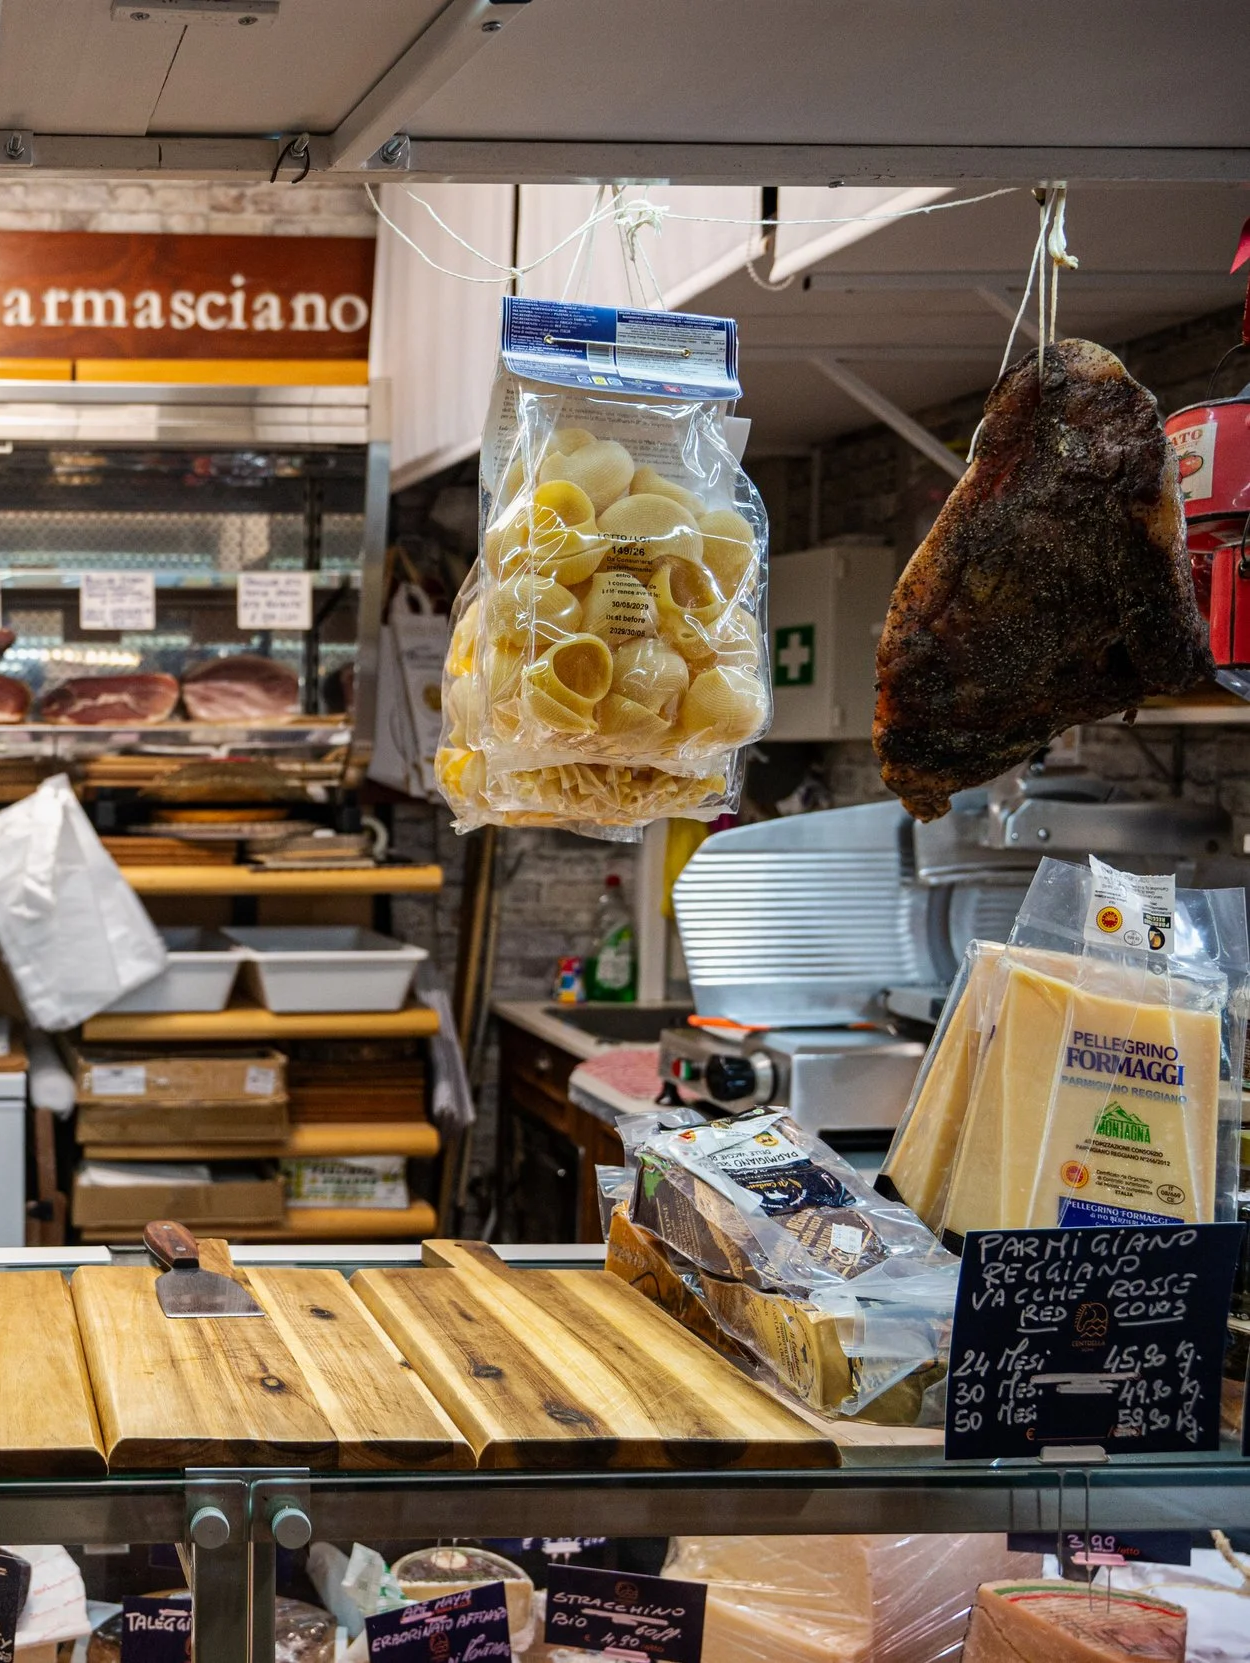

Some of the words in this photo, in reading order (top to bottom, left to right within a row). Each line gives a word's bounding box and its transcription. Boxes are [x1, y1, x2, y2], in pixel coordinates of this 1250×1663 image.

[612, 546, 645, 556] 149/26
[611, 601, 649, 610] 30/05/2029
[623, 615, 645, 623] before
[609, 627, 646, 637] 2029/30/05
[1073, 1030, 1179, 1062] PELLEGRINO
[1066, 1046, 1186, 1086] FORMAGGI
[1061, 1075, 1129, 1095] PARMIGIANO
[1131, 1087, 1188, 1105] REGGIANO
[1095, 1118, 1151, 1144] MONTAGNA
[734, 1151, 799, 1167] PARMIGIANO
[1066, 1200, 1119, 1216] PELLEGRINO
[1120, 1210, 1170, 1225] FORMAGGI
[978, 1229, 1198, 1264] PARMIGIANO
[982, 1255, 1140, 1288] REGGIANO
[972, 1283, 1088, 1311] VACCHE
[1107, 1273, 1198, 1299] ROSSE
[1020, 1305, 1068, 1327] RED
[1113, 1300, 1187, 1318] COWS
[952, 1350, 991, 1377] 24
[954, 1382, 985, 1406] 30
[954, 1411, 983, 1433] 50
[1026, 1426, 1036, 1441] €
[1066, 1533, 1117, 1553] 399
[552, 1591, 686, 1617] STRACCHINO
[125, 1612, 192, 1632] TALEGGI
[551, 1612, 588, 1628] BIO
